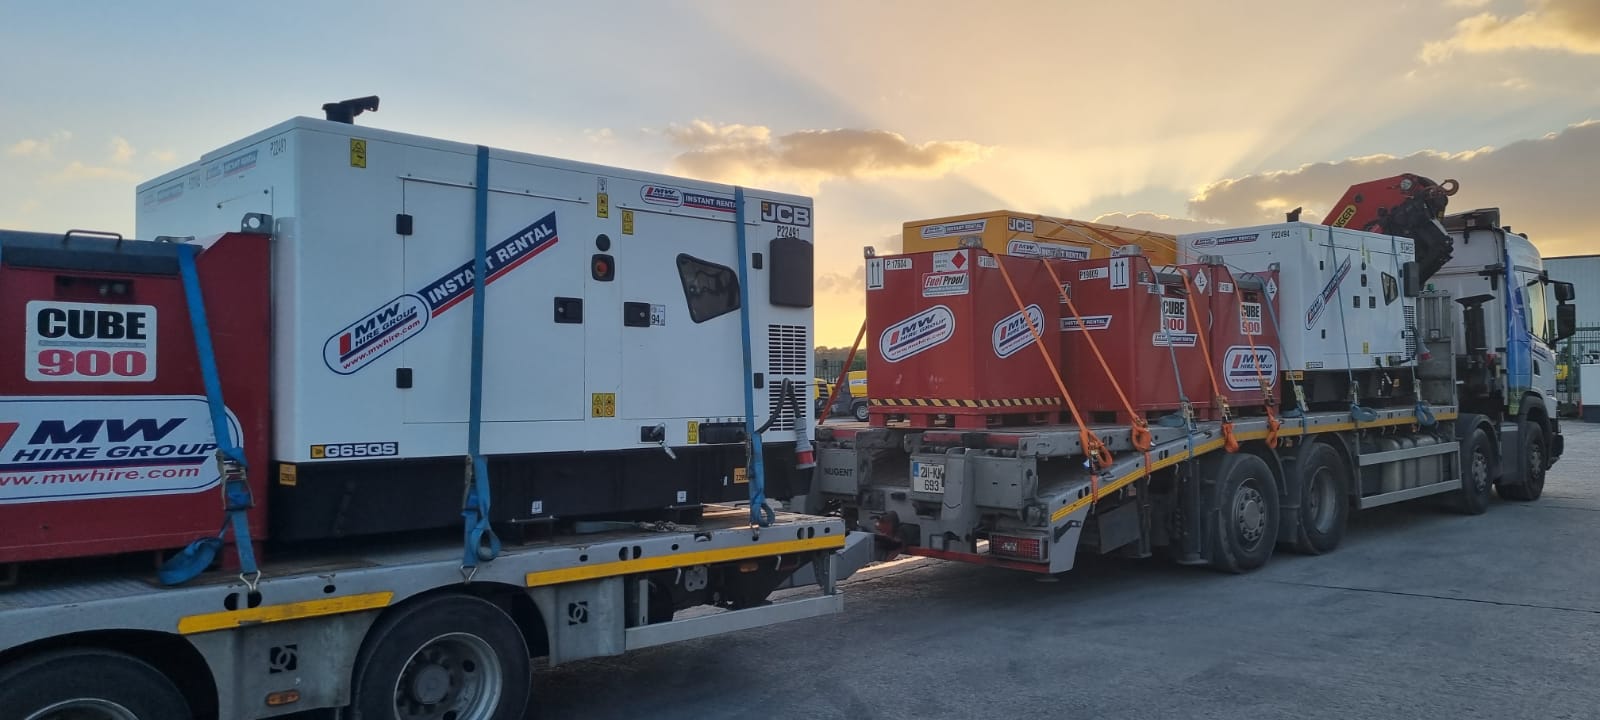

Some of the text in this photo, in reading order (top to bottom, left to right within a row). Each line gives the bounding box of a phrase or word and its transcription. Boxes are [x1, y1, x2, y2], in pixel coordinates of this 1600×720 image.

[685, 195, 714, 206] INSTANT
[716, 200, 736, 208] RENTA
[763, 204, 810, 226] JCB
[1009, 218, 1033, 232] JCB
[428, 223, 553, 303] INSTAT RENTAL
[926, 274, 964, 286] Fuel Proof
[1163, 300, 1185, 316] CUBE
[37, 308, 147, 340] CUBE
[355, 303, 400, 339] MW
[356, 305, 417, 347] HIRE GROUP
[651, 314, 660, 324] 94
[902, 313, 936, 336] MW
[343, 319, 421, 369] www.mwhire.com
[38, 349, 147, 377] 900
[1242, 354, 1268, 363] MW
[27, 418, 188, 445] MW
[12, 444, 218, 462] HIRE GROUP
[325, 443, 396, 458] G65QS
[824, 468, 854, 478] NUGENT
[924, 479, 940, 491] 693
